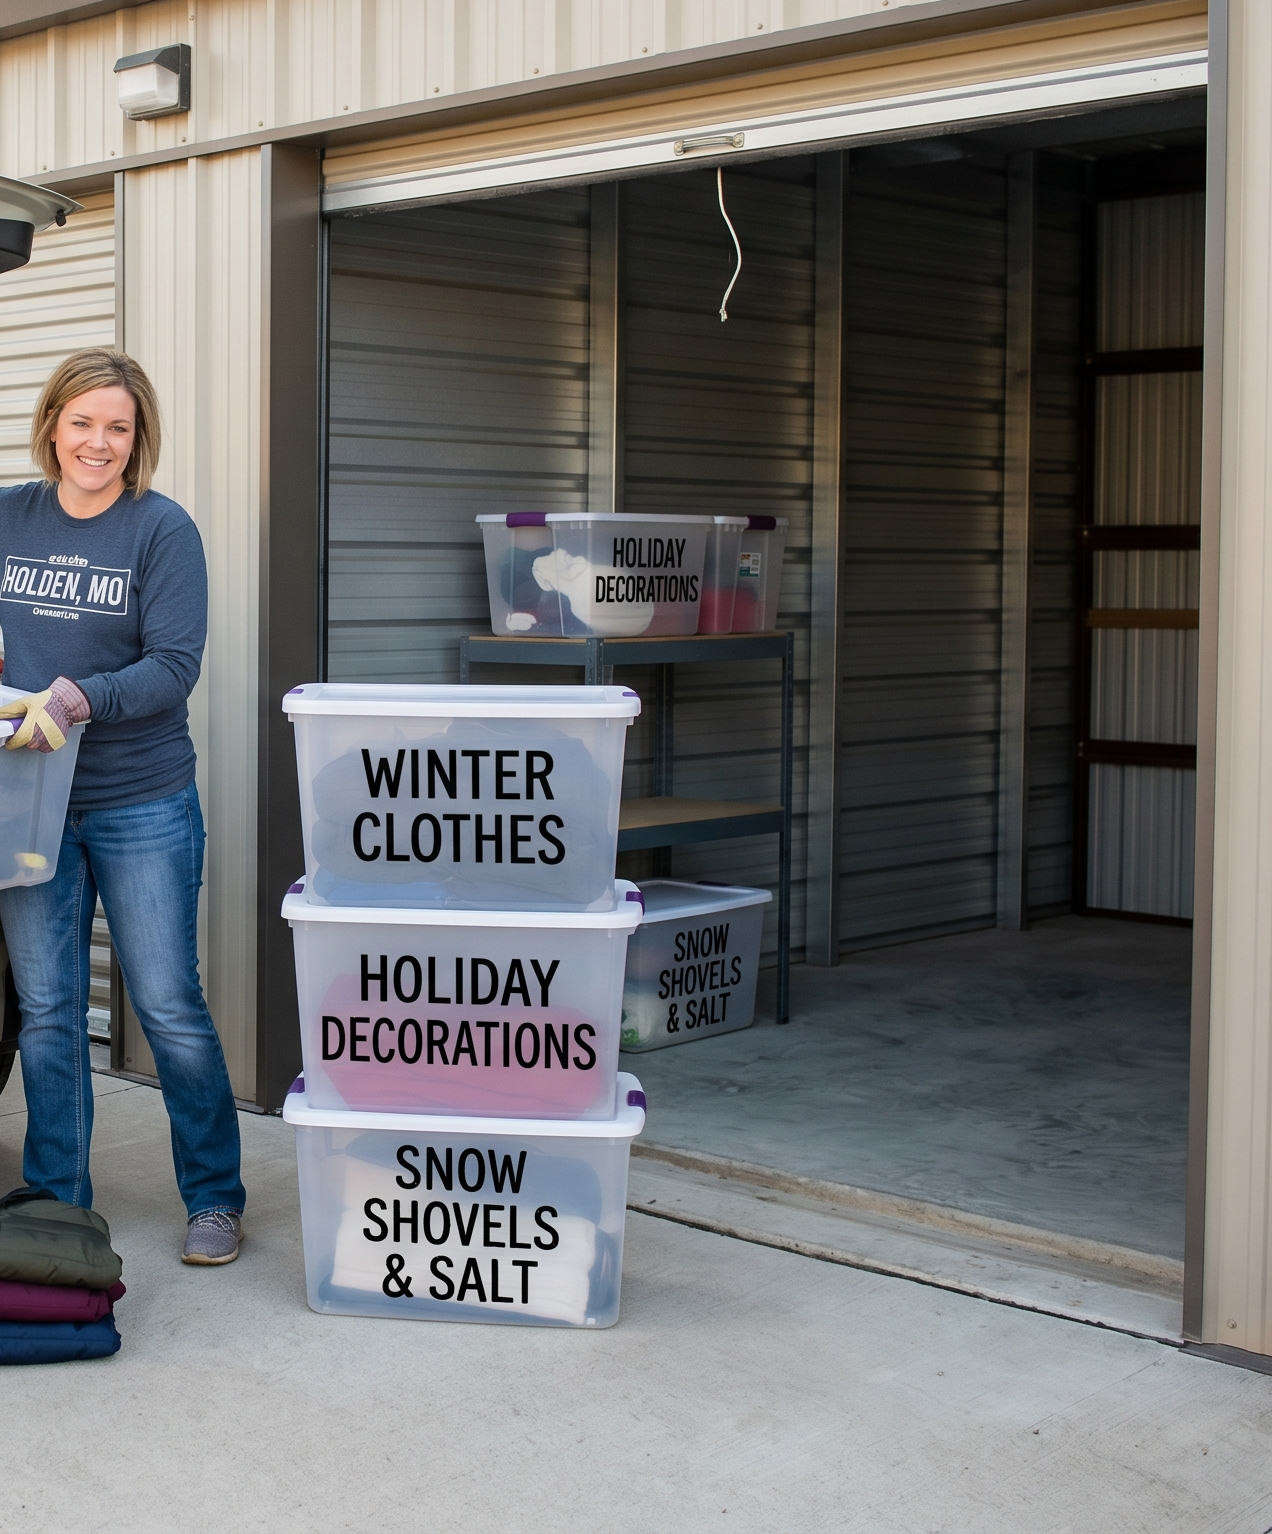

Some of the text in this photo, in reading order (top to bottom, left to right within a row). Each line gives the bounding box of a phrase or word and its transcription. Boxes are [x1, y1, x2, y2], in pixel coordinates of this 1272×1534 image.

[613, 537, 687, 569] HOLIDAY
[3, 564, 124, 606] HOLDEN, MO
[595, 575, 700, 603] DECORATIONS
[361, 748, 555, 800] WINTER
[352, 811, 566, 865] CLOTHES
[674, 923, 730, 963] SNOW
[360, 954, 561, 1008] HOLIDAY
[658, 956, 742, 1000] SHOVELS
[666, 992, 731, 1034] & SALT
[321, 1015, 597, 1071] DECORATIONS
[395, 1144, 528, 1194] SNOW
[362, 1197, 560, 1251] SHOVELS
[382, 1253, 539, 1304] & SALT
